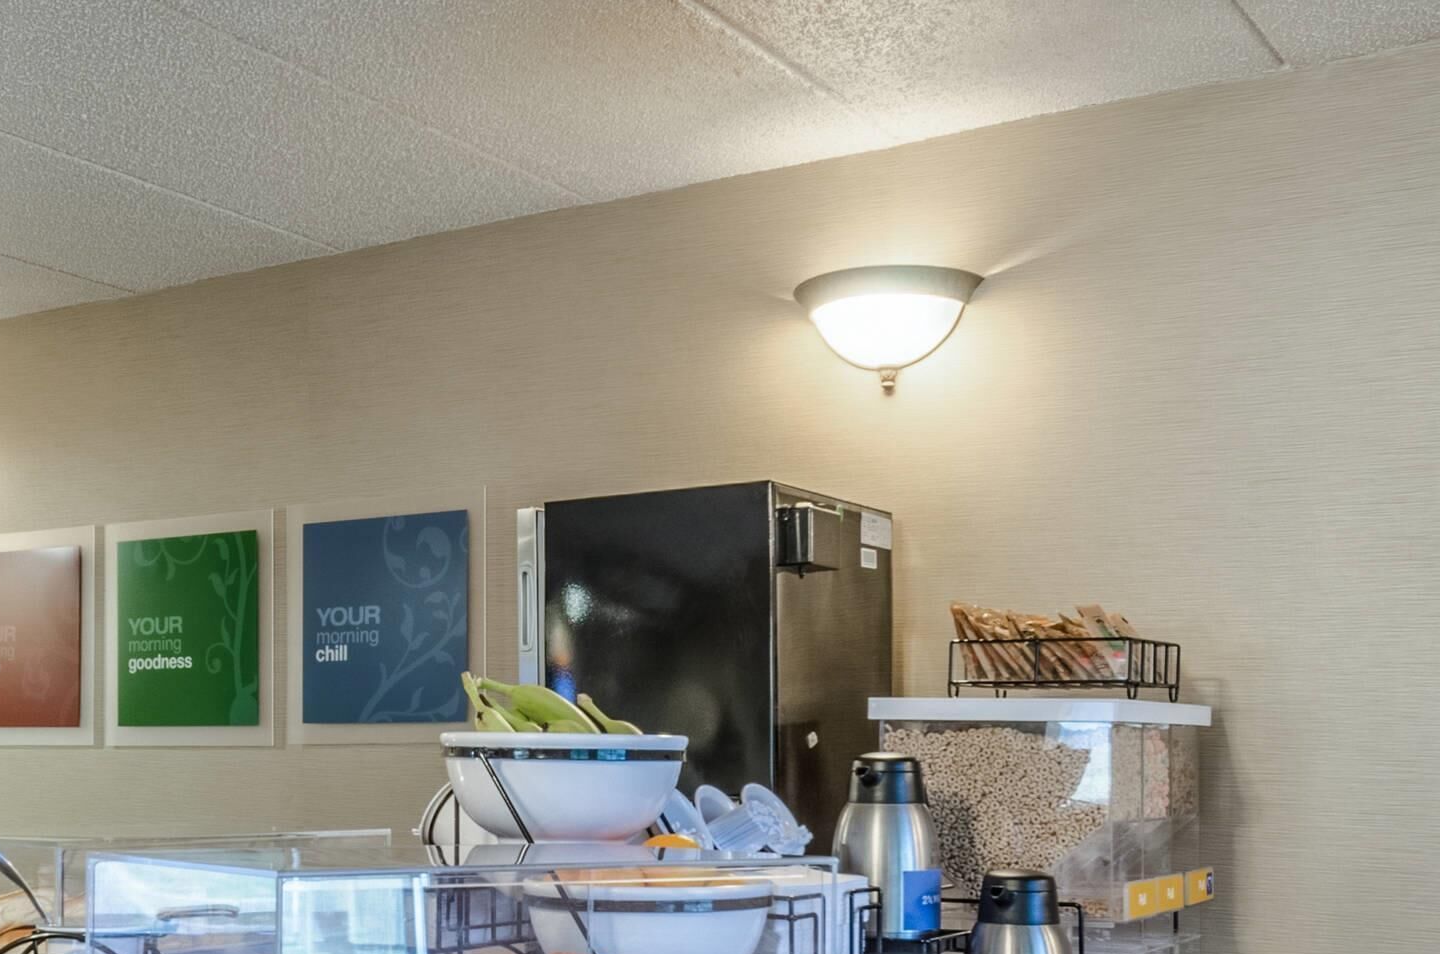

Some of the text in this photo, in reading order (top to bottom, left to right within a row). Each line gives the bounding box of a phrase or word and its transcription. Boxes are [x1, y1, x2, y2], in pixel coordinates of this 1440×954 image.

[128, 615, 183, 635] YOUR
[316, 605, 381, 627] YOUR
[128, 636, 182, 655] morning
[316, 626, 380, 647] morning
[315, 644, 348, 662] chill
[128, 653, 193, 674] goodness
